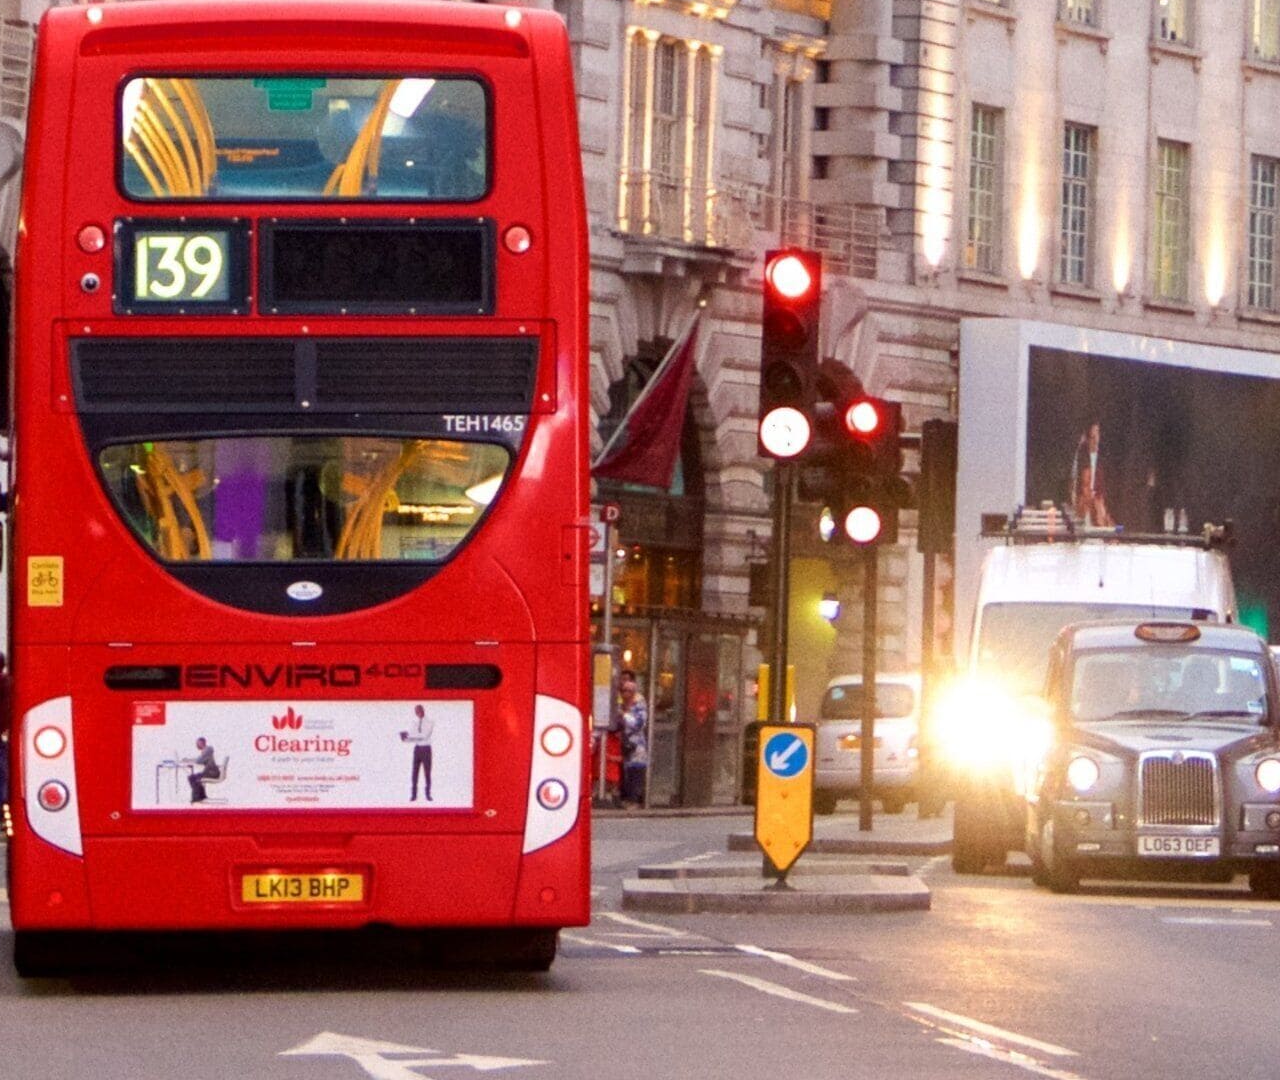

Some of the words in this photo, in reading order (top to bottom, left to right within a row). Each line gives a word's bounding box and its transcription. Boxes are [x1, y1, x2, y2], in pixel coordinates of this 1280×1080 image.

[136, 236, 222, 298] 139
[442, 414, 524, 432] TEH1465
[606, 505, 619, 520] D
[254, 734, 352, 756] Clearing
[255, 878, 302, 897] LK13
[308, 878, 349, 897] BHP
